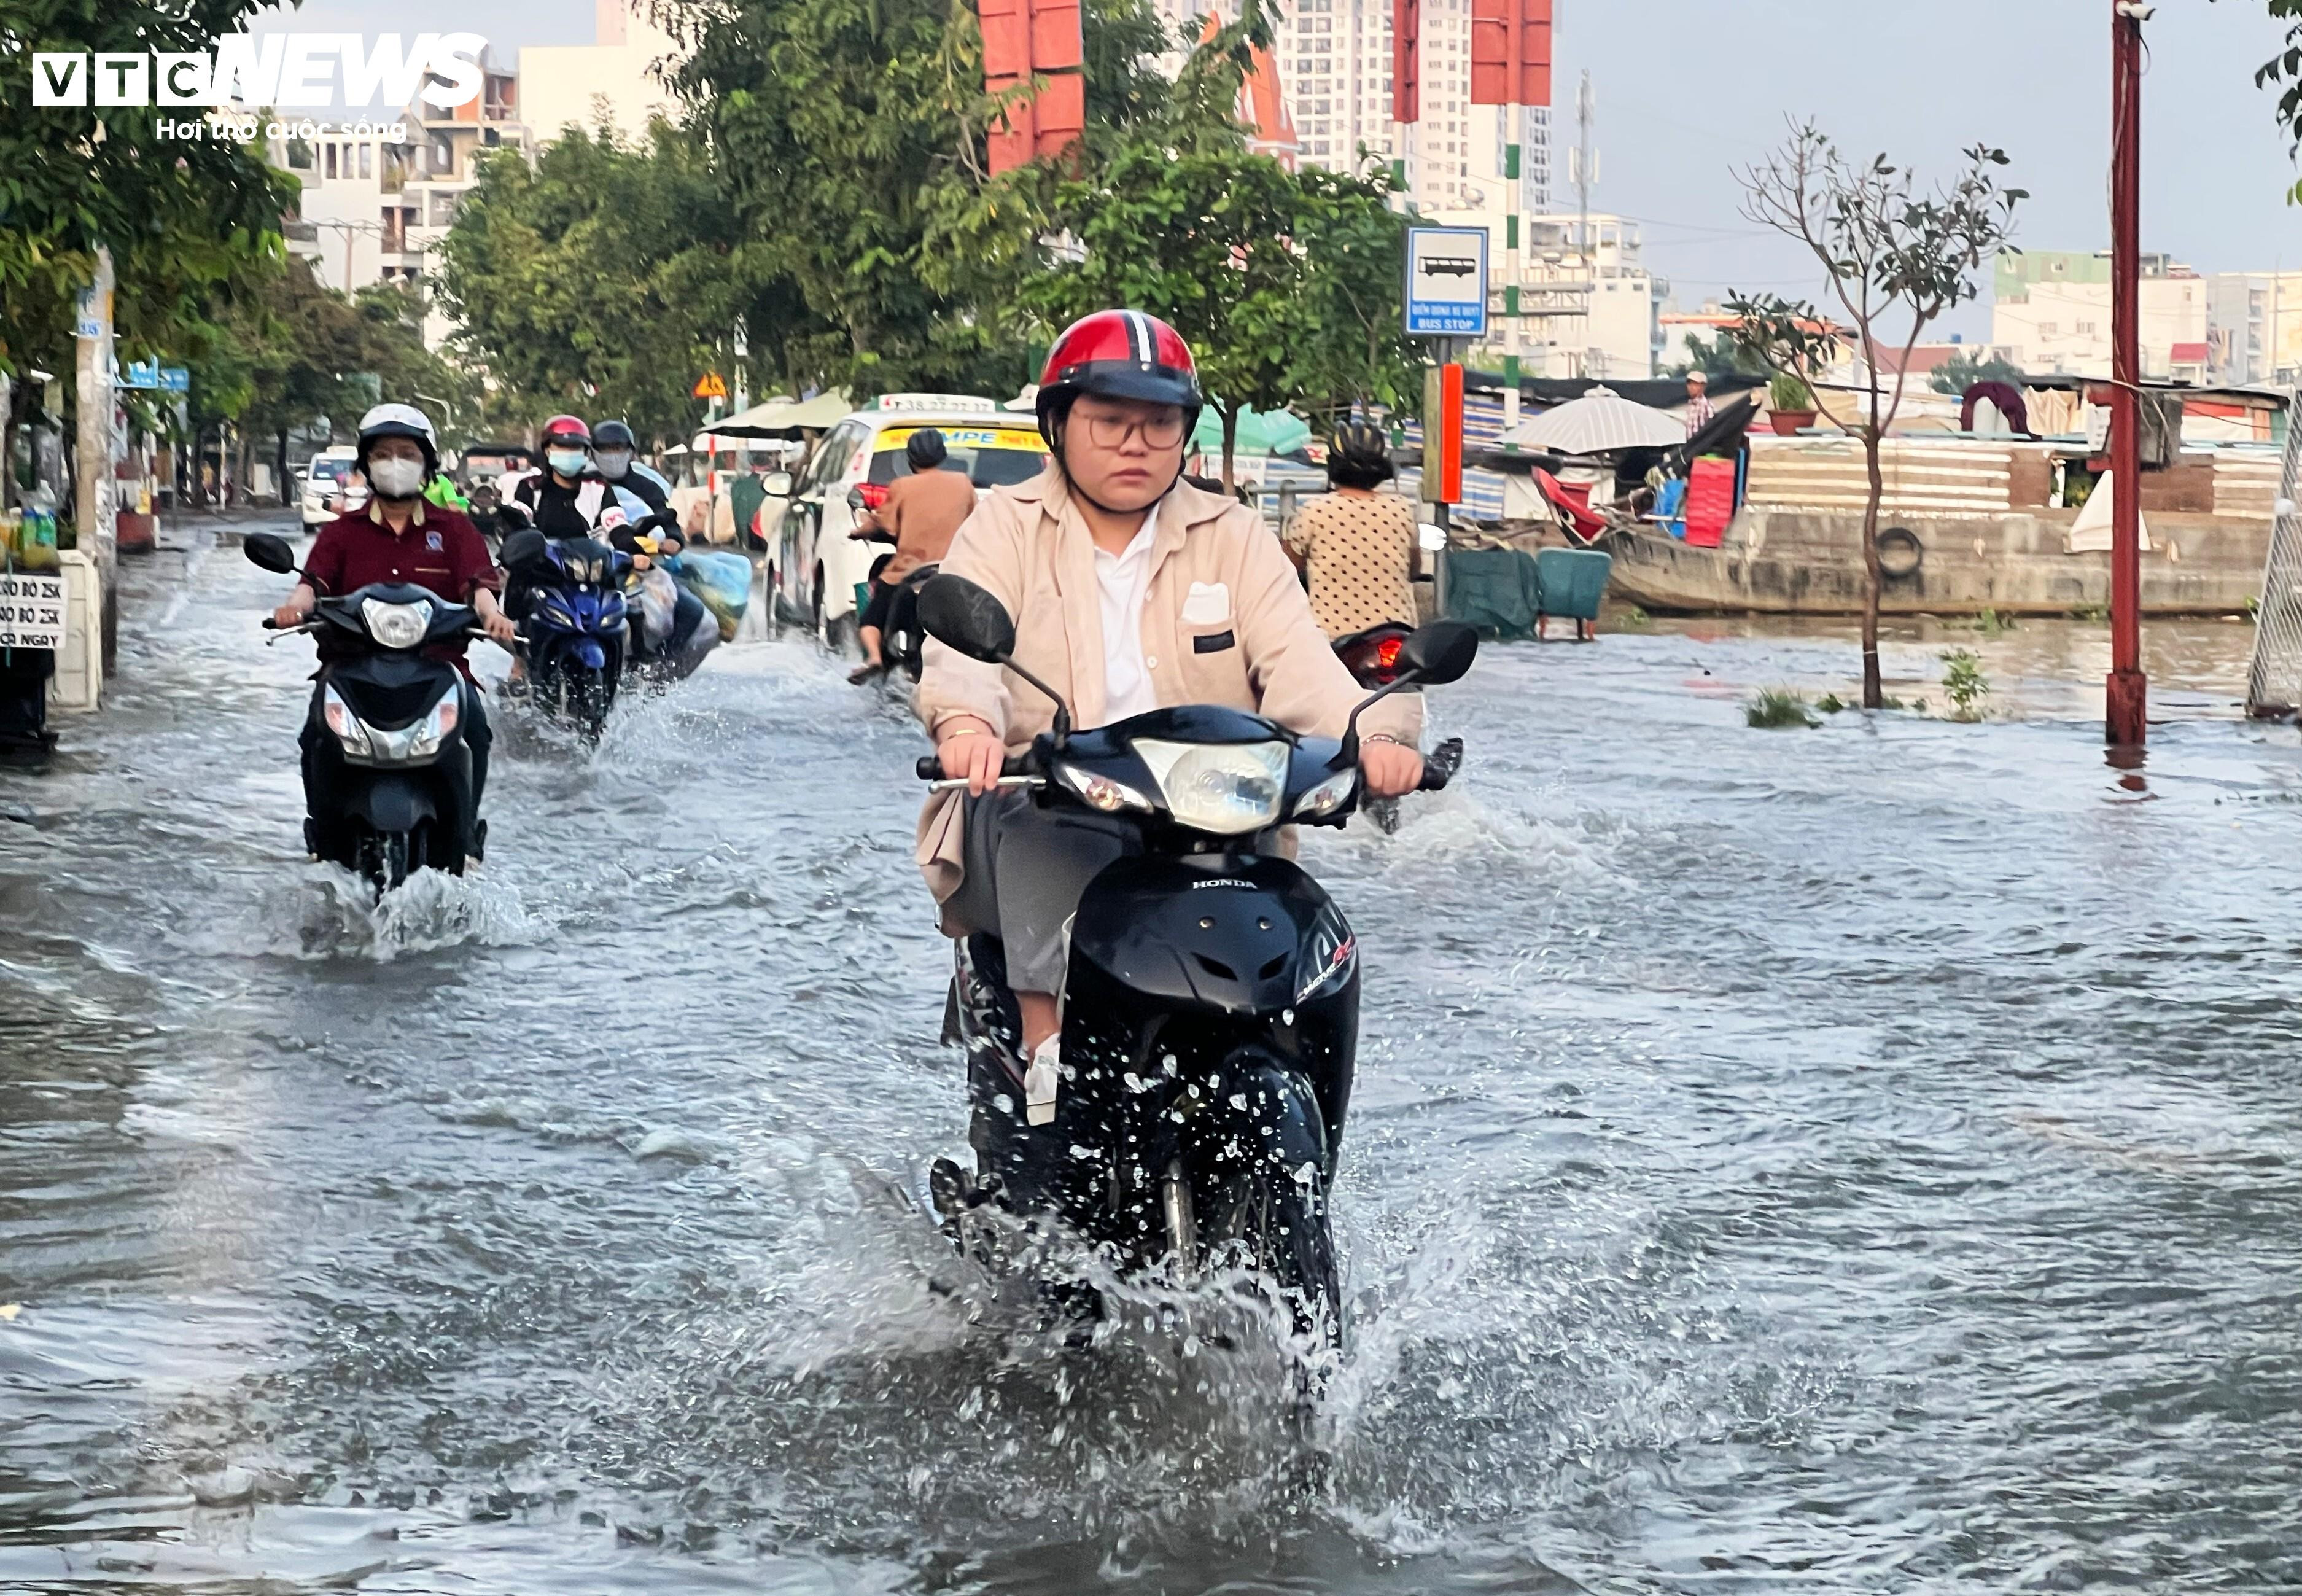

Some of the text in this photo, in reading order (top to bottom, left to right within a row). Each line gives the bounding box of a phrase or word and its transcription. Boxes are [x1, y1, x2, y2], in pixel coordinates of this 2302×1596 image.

[1418, 317, 1474, 330] BUS STOP
[1192, 879, 1258, 889] HONDA
